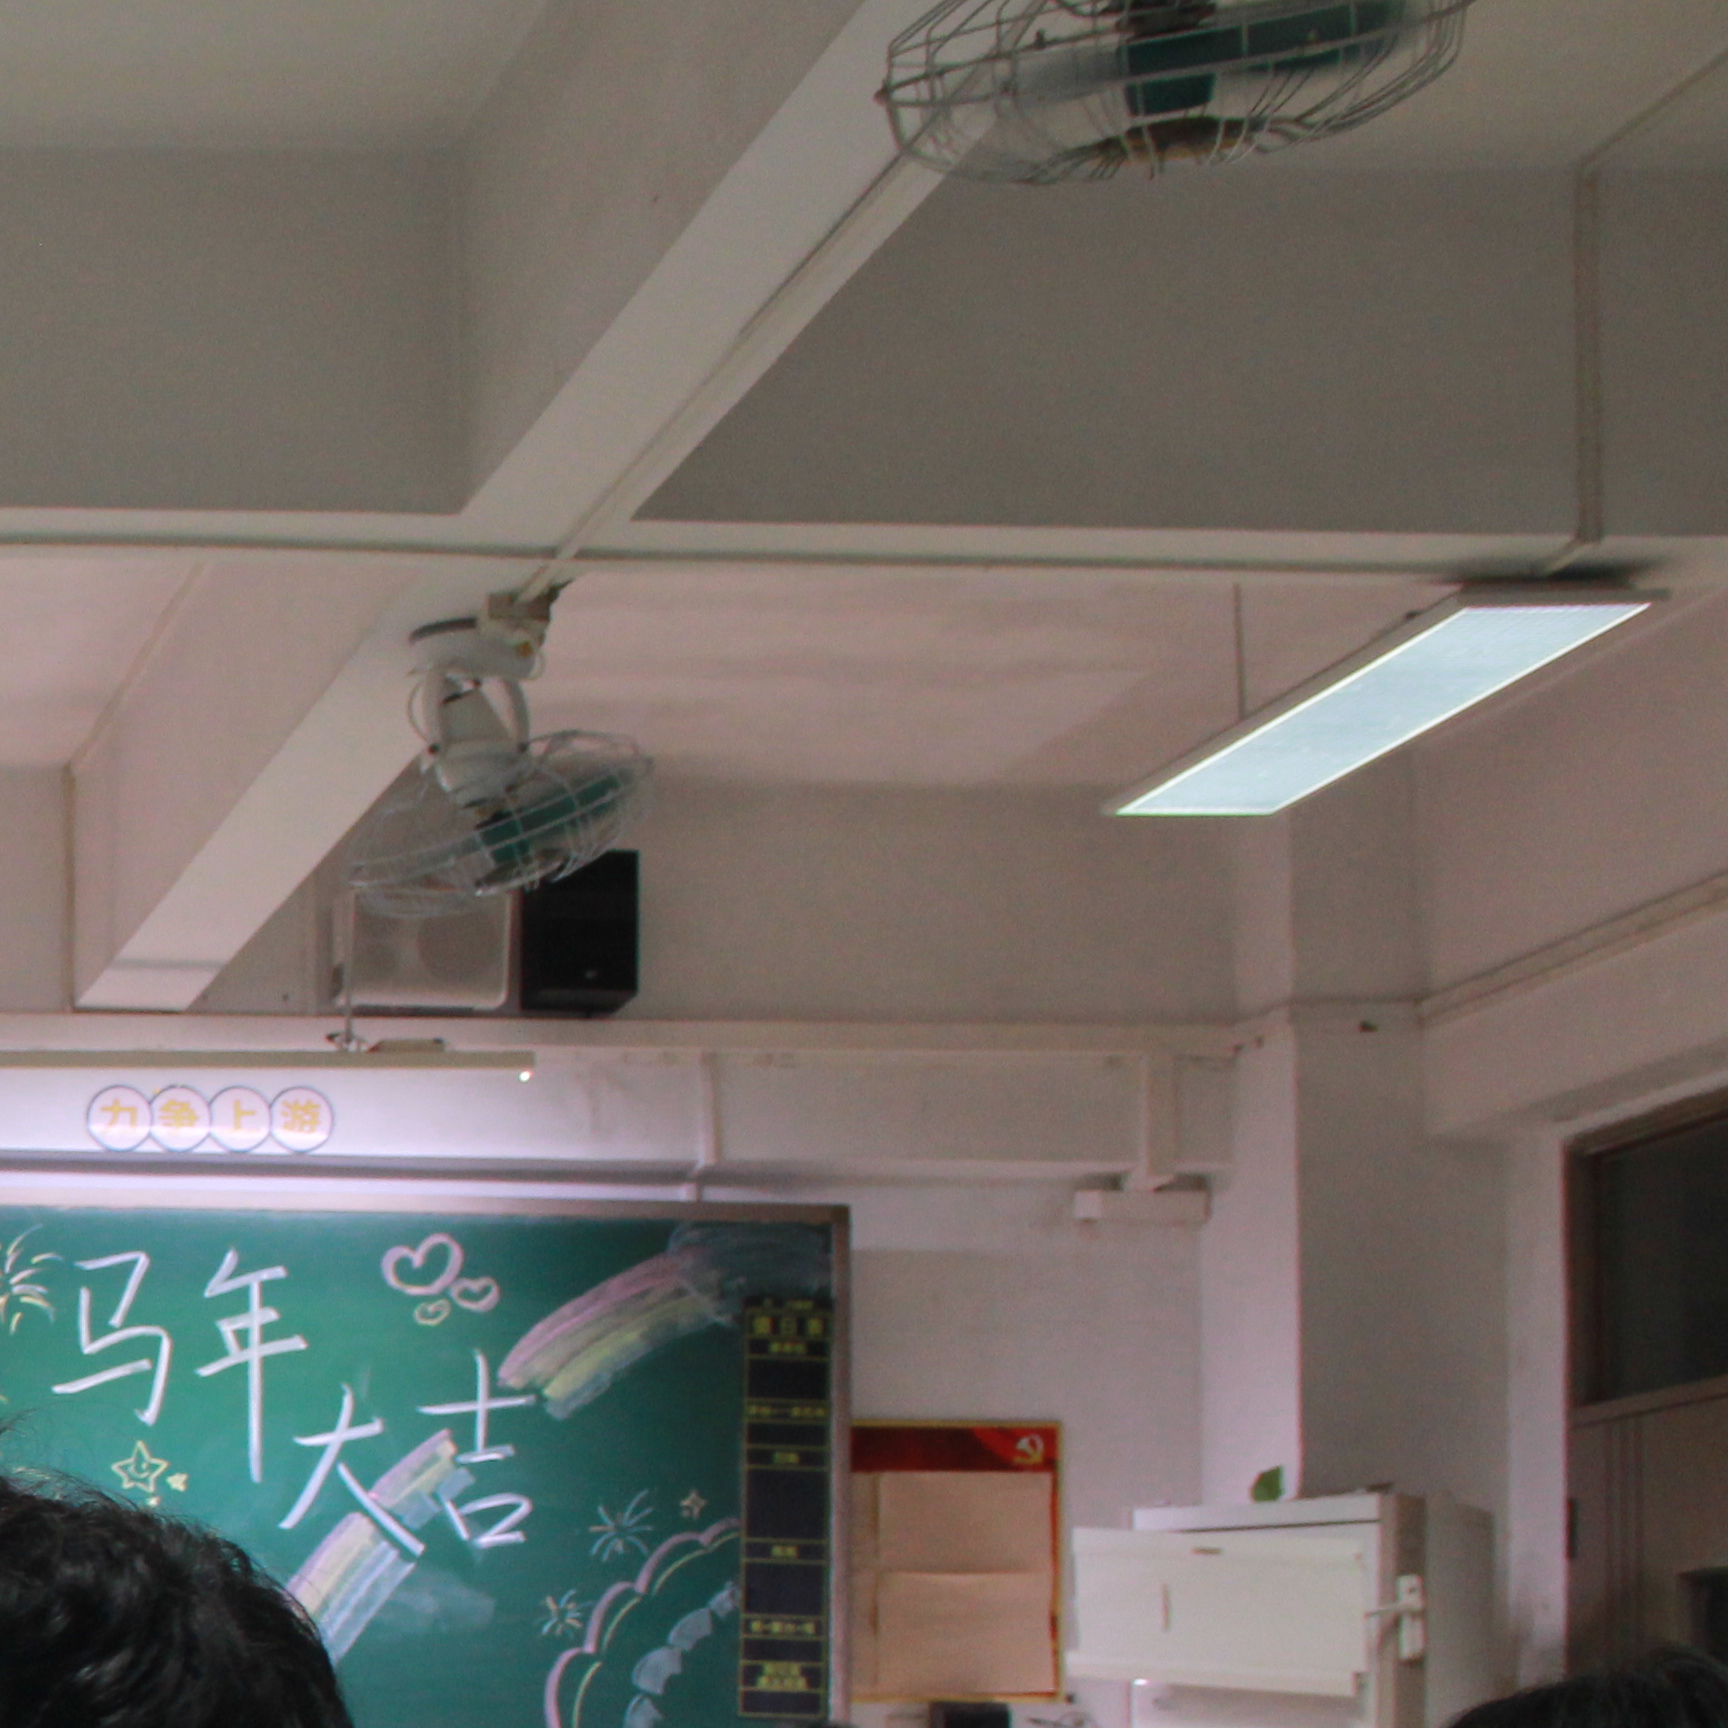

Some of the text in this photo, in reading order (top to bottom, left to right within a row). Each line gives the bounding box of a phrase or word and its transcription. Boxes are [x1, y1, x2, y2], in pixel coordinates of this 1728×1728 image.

[100, 1098, 322, 1136] 力争上游
[50, 1246, 308, 1484] 马年
[279, 1348, 538, 1556] 大吉
